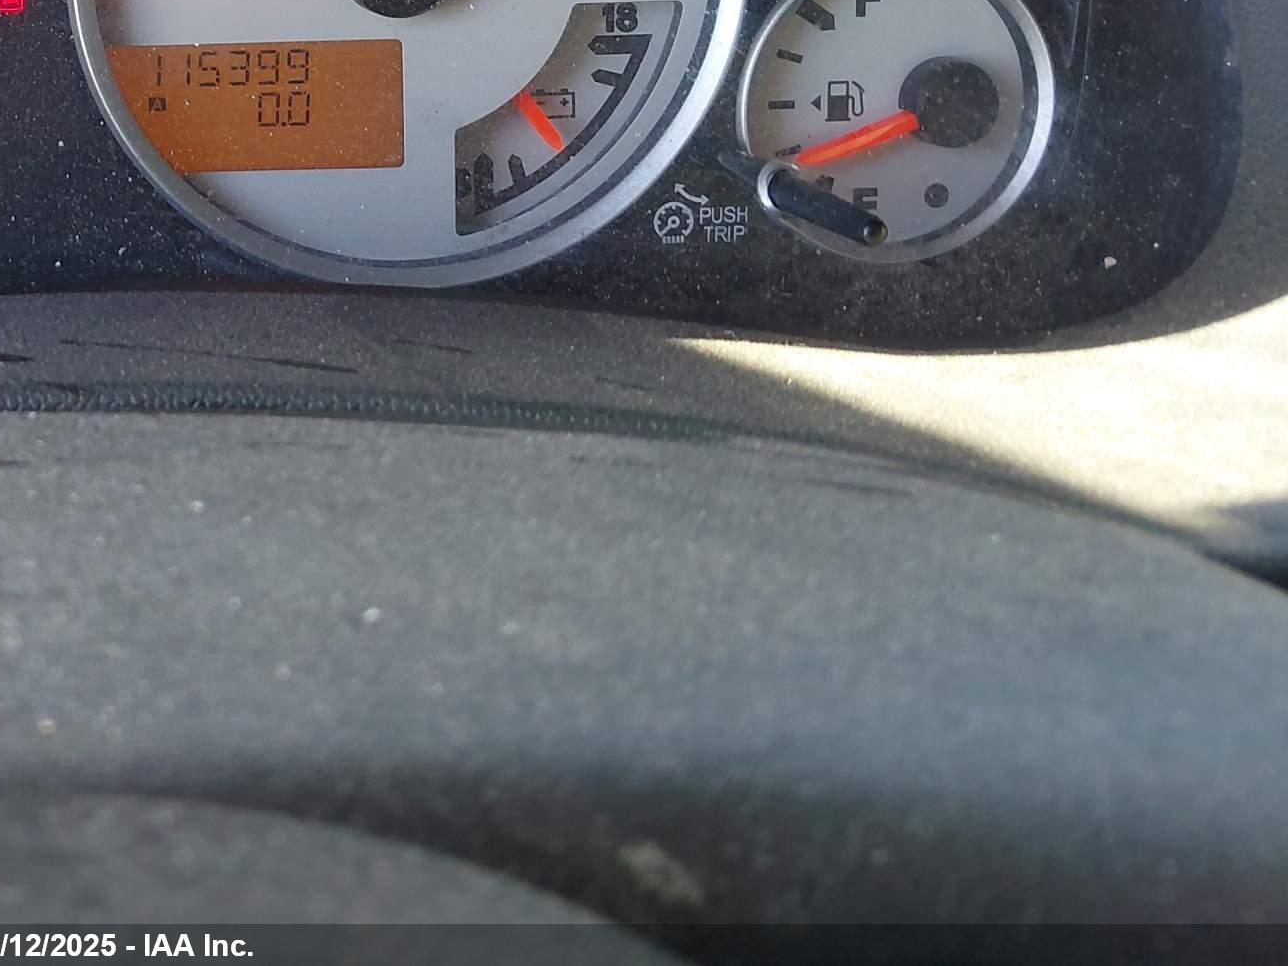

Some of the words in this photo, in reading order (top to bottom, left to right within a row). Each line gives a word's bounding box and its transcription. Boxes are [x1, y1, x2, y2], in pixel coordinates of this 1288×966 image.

[603, 3, 638, 32] 18
[155, 48, 310, 87] 115399
[258, 91, 311, 128] 0.0
[699, 206, 749, 225] PUSH
[704, 225, 746, 243] TRIP
